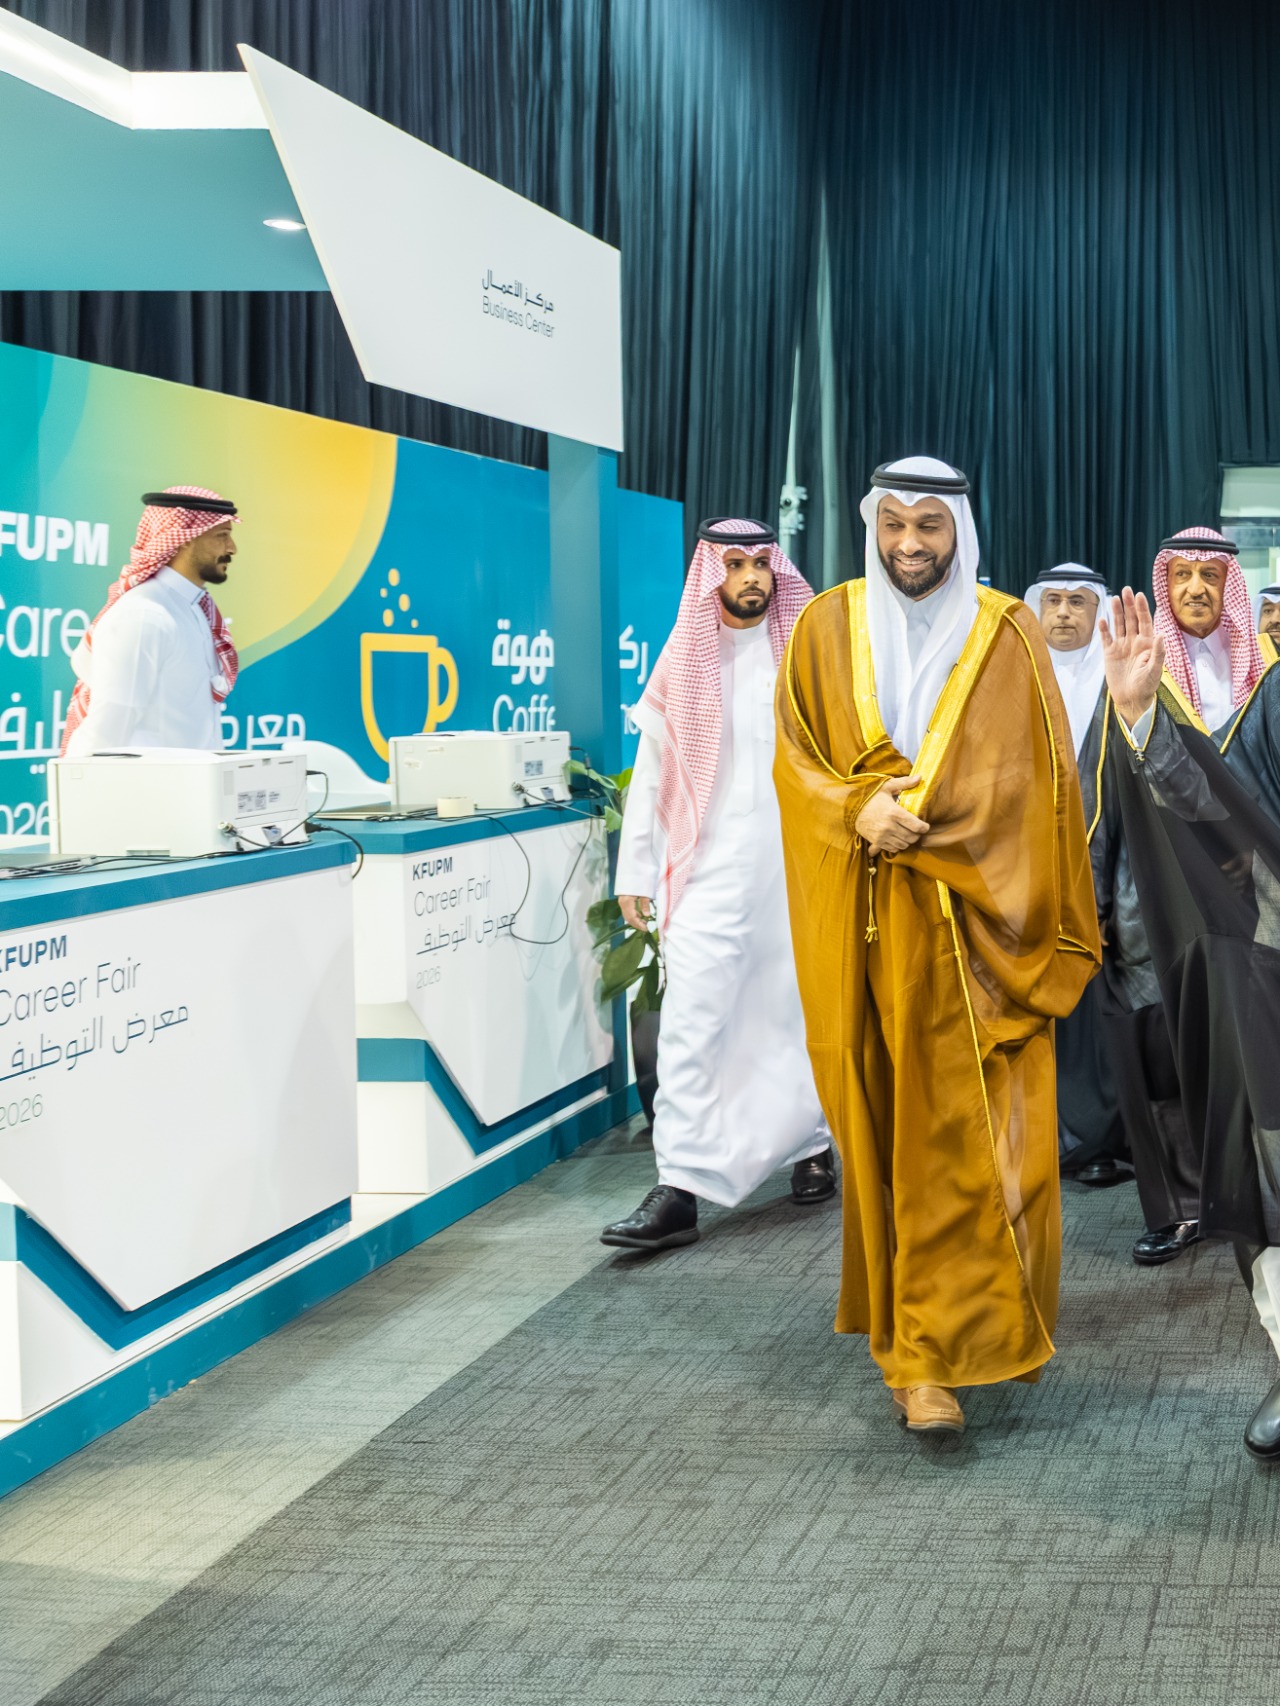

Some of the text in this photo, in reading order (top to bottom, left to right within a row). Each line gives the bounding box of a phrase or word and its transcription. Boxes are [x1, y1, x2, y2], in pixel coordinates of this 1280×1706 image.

[481, 268, 554, 314] مركز الأعمال
[482, 295, 555, 338] Business Center
[0, 510, 109, 567] FUPM
[412, 856, 453, 881] KFUPM
[414, 875, 491, 917] Career Fair
[0, 934, 68, 973] FUPM
[416, 912, 517, 956] معرض التوظيف
[96, 956, 141, 999] Fair
[416, 965, 442, 990] 2026
[112, 1005, 189, 1054] معرض
